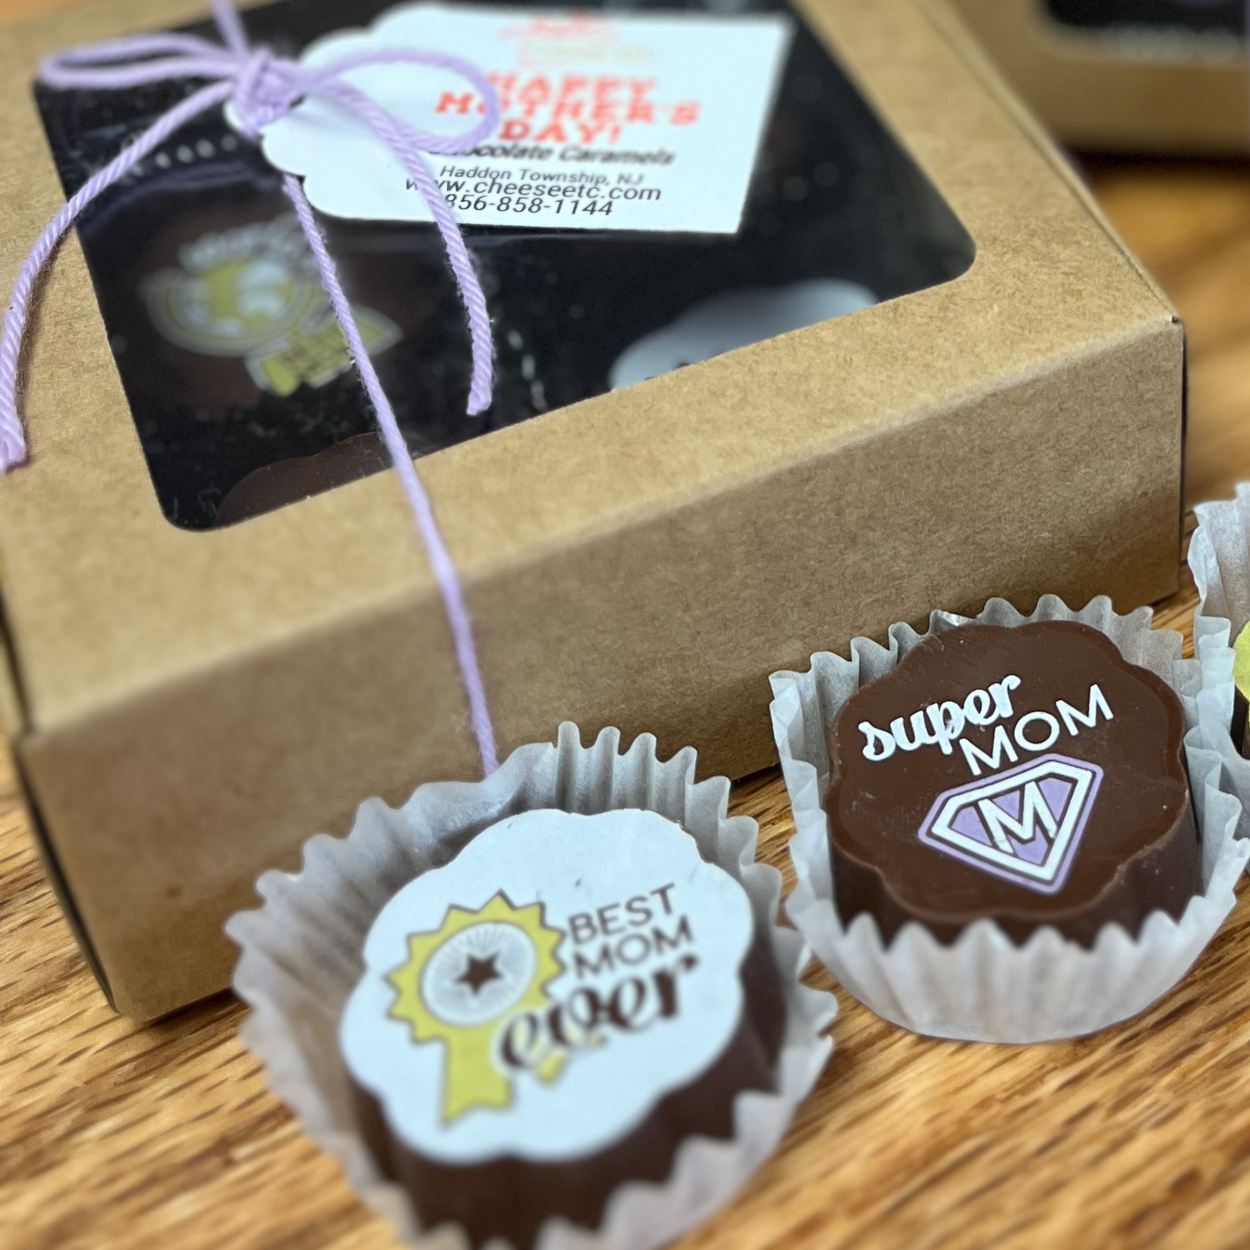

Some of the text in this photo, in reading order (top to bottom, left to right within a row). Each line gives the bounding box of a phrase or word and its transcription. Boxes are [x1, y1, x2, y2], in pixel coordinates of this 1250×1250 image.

[440, 165, 645, 187] Haddon Township, NJ
[858, 674, 1021, 762] super
[959, 683, 1114, 775] MOM
[567, 883, 676, 945] BEST
[572, 914, 694, 980] MOM
[501, 953, 699, 1070] ever
